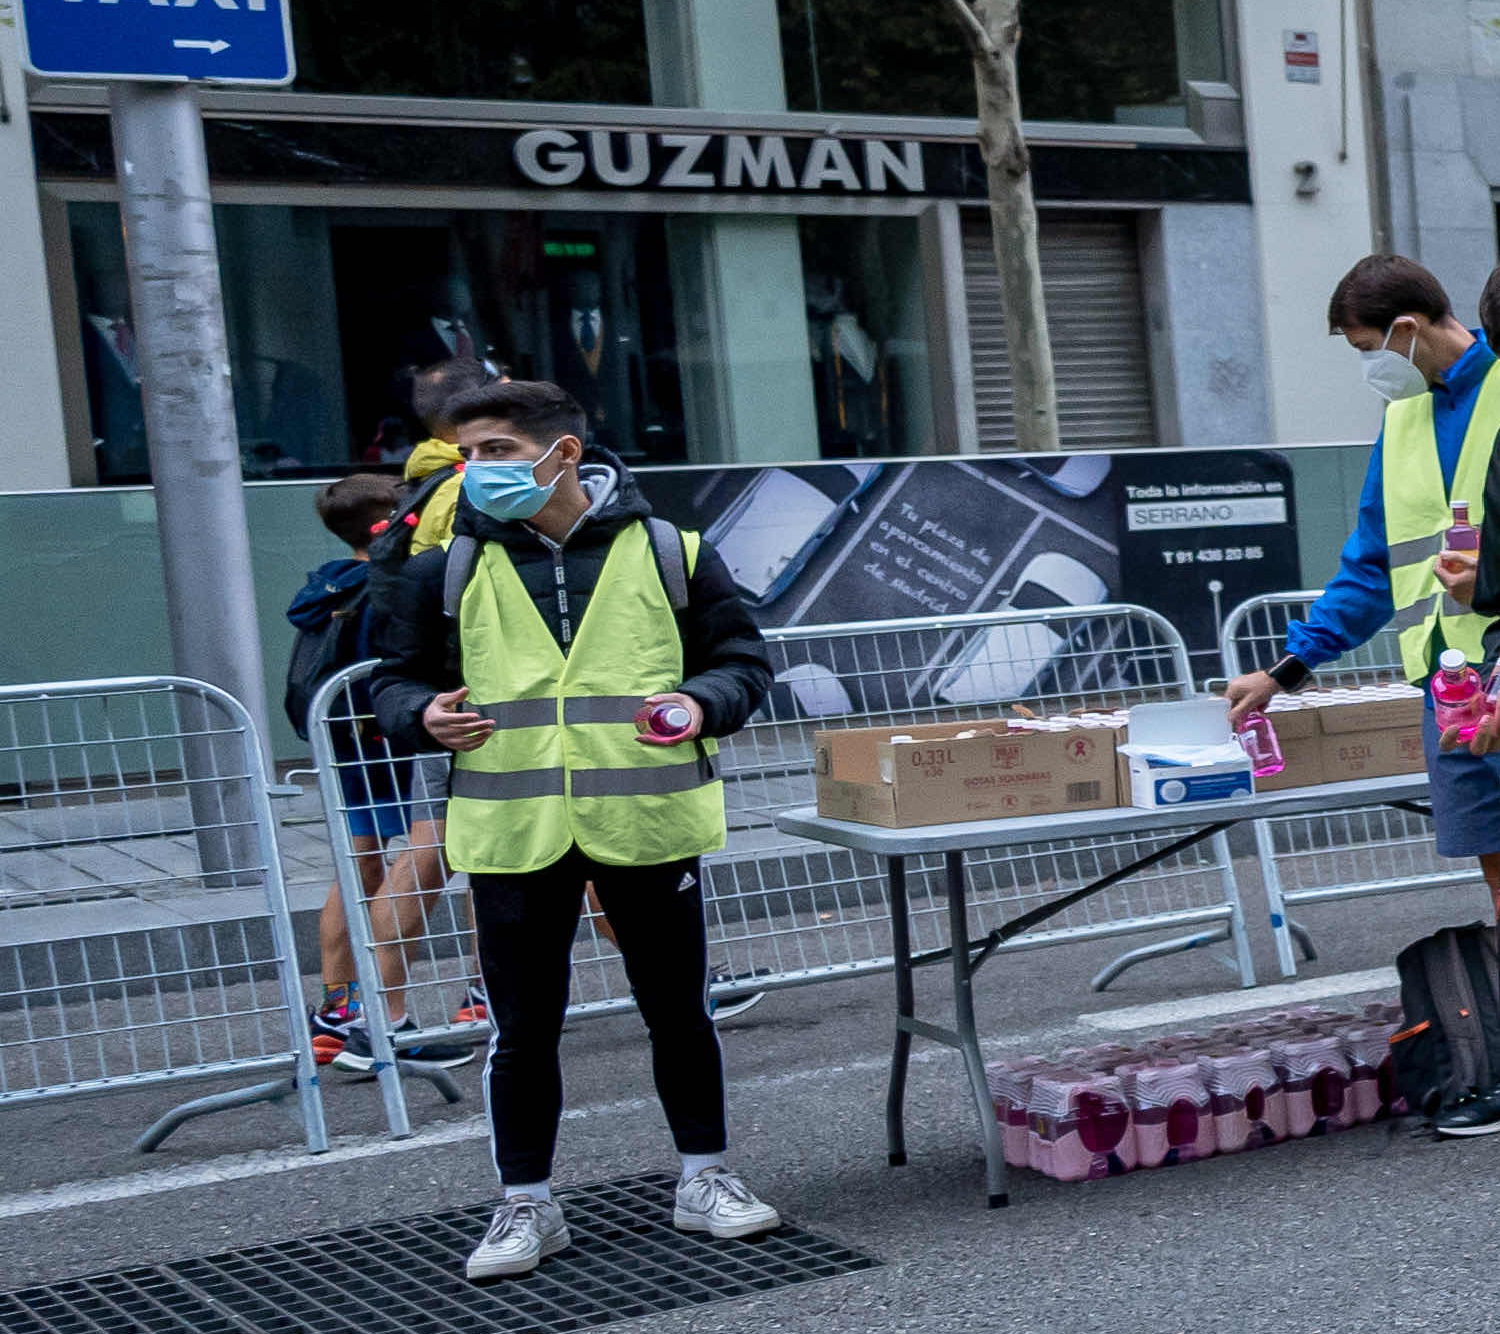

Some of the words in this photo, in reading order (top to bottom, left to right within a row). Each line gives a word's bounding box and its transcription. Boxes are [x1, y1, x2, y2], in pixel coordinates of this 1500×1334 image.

[513, 123, 926, 192] GUZMÁN
[1126, 485, 1163, 499] Toda
[1135, 505, 1232, 525] SERRANO
